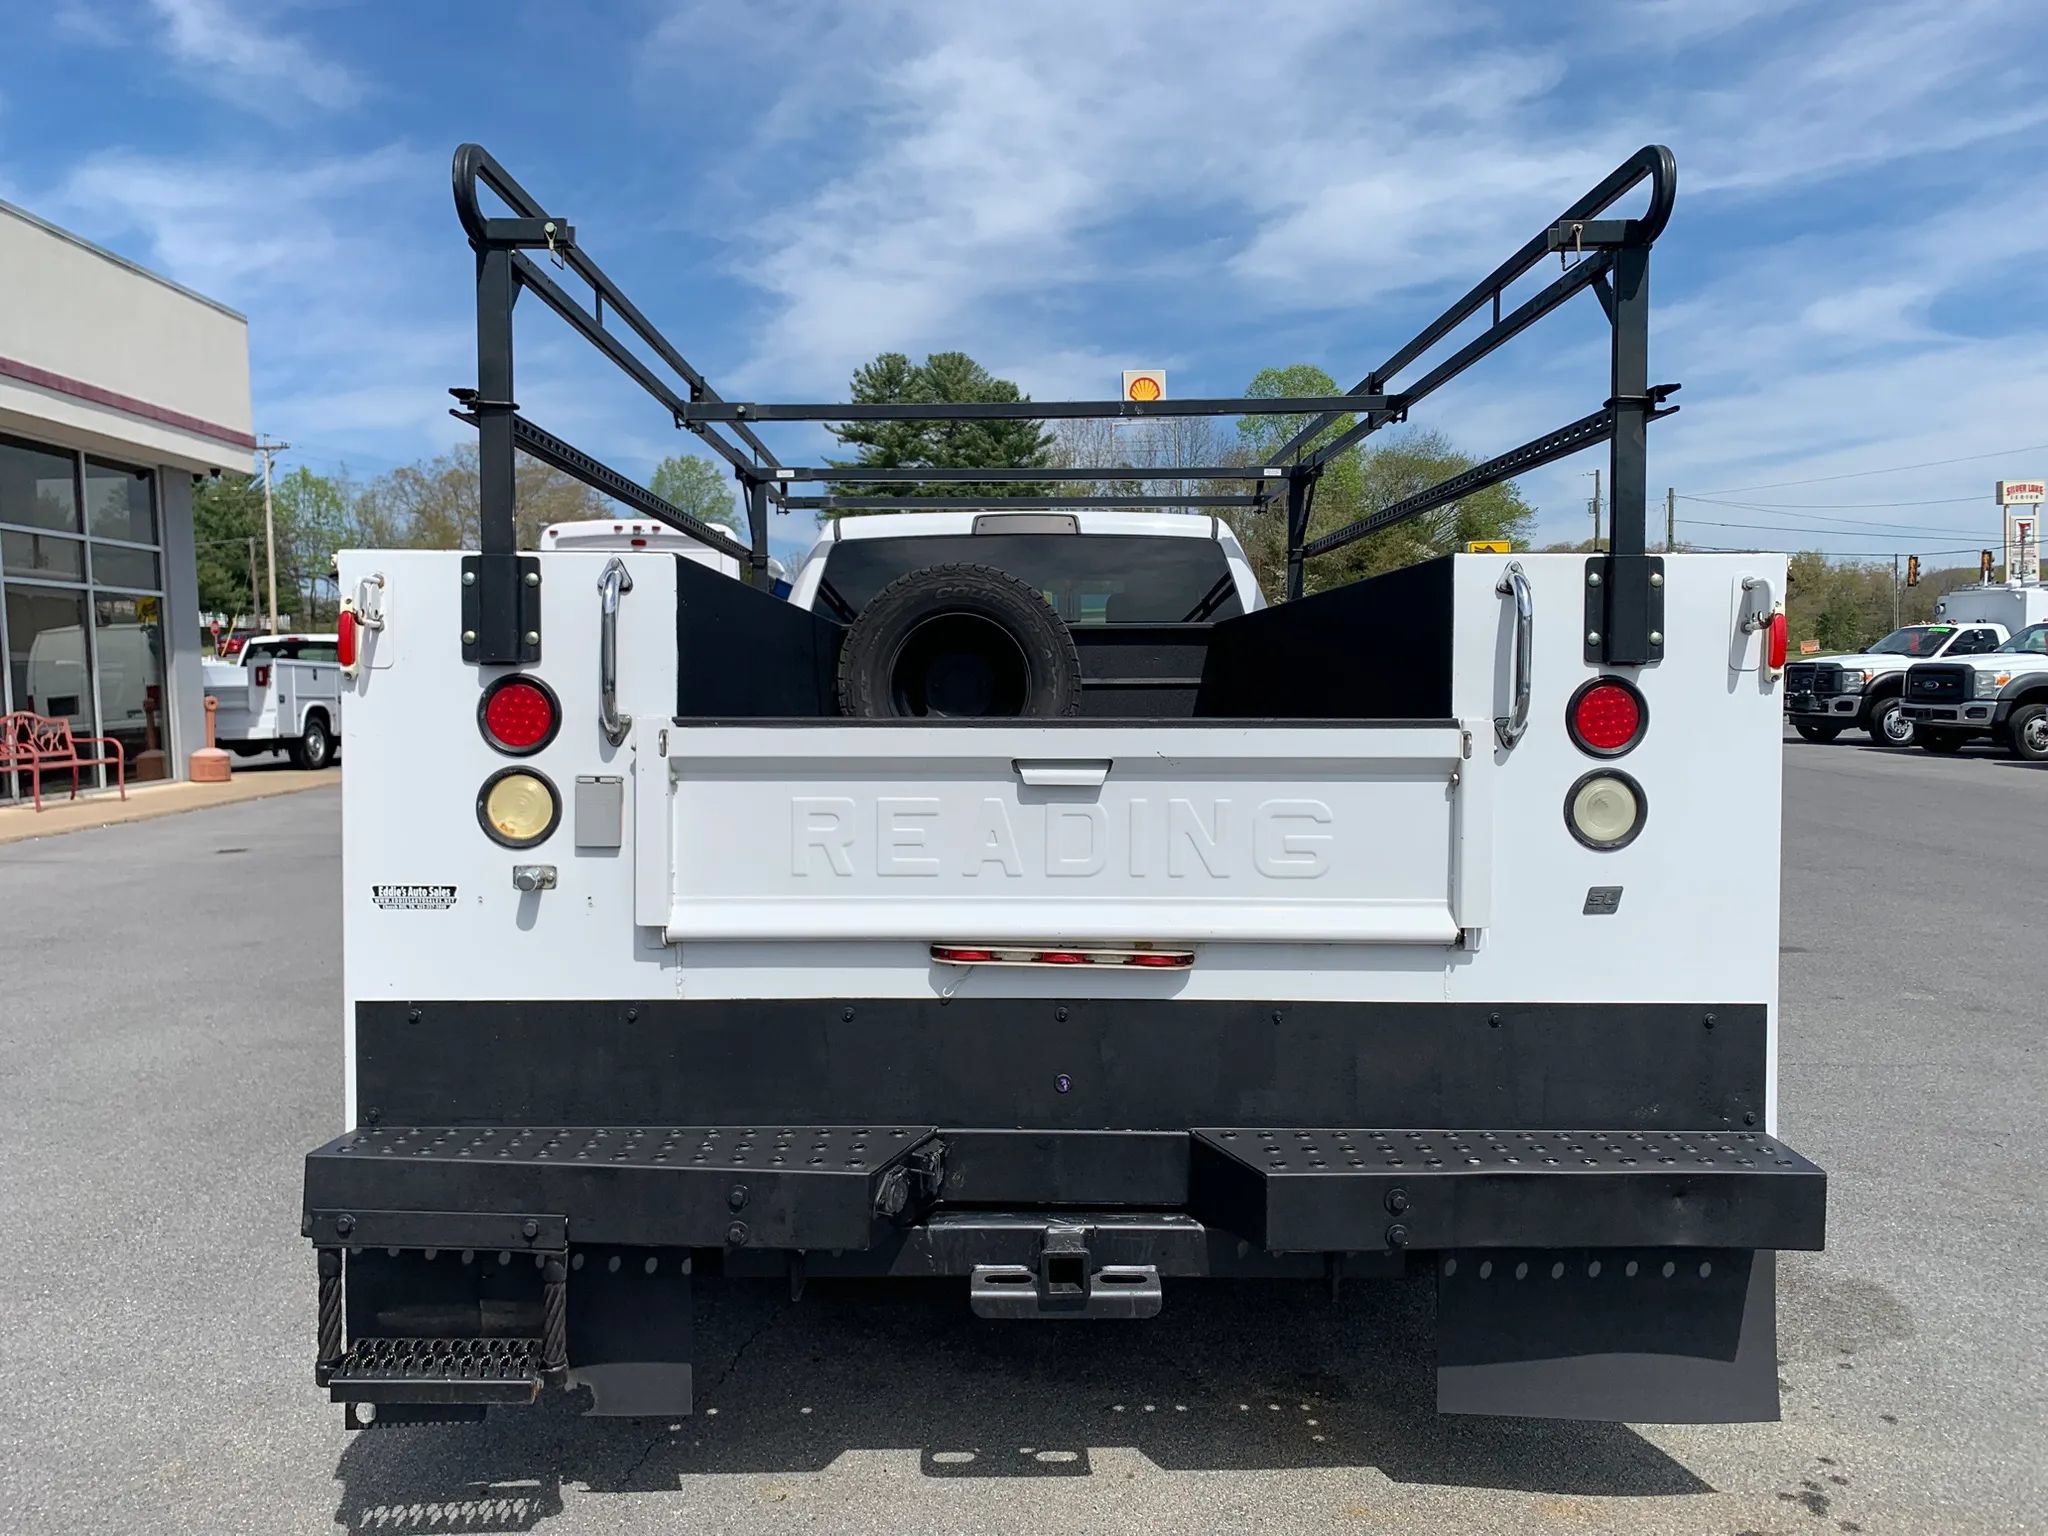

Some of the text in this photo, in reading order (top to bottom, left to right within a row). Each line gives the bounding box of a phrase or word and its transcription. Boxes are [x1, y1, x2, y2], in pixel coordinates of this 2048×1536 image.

[2006, 483, 2044, 496] SILVER LAKE
[790, 796, 1334, 879] READING
[378, 886, 451, 897] Eddie's Auto Sales
